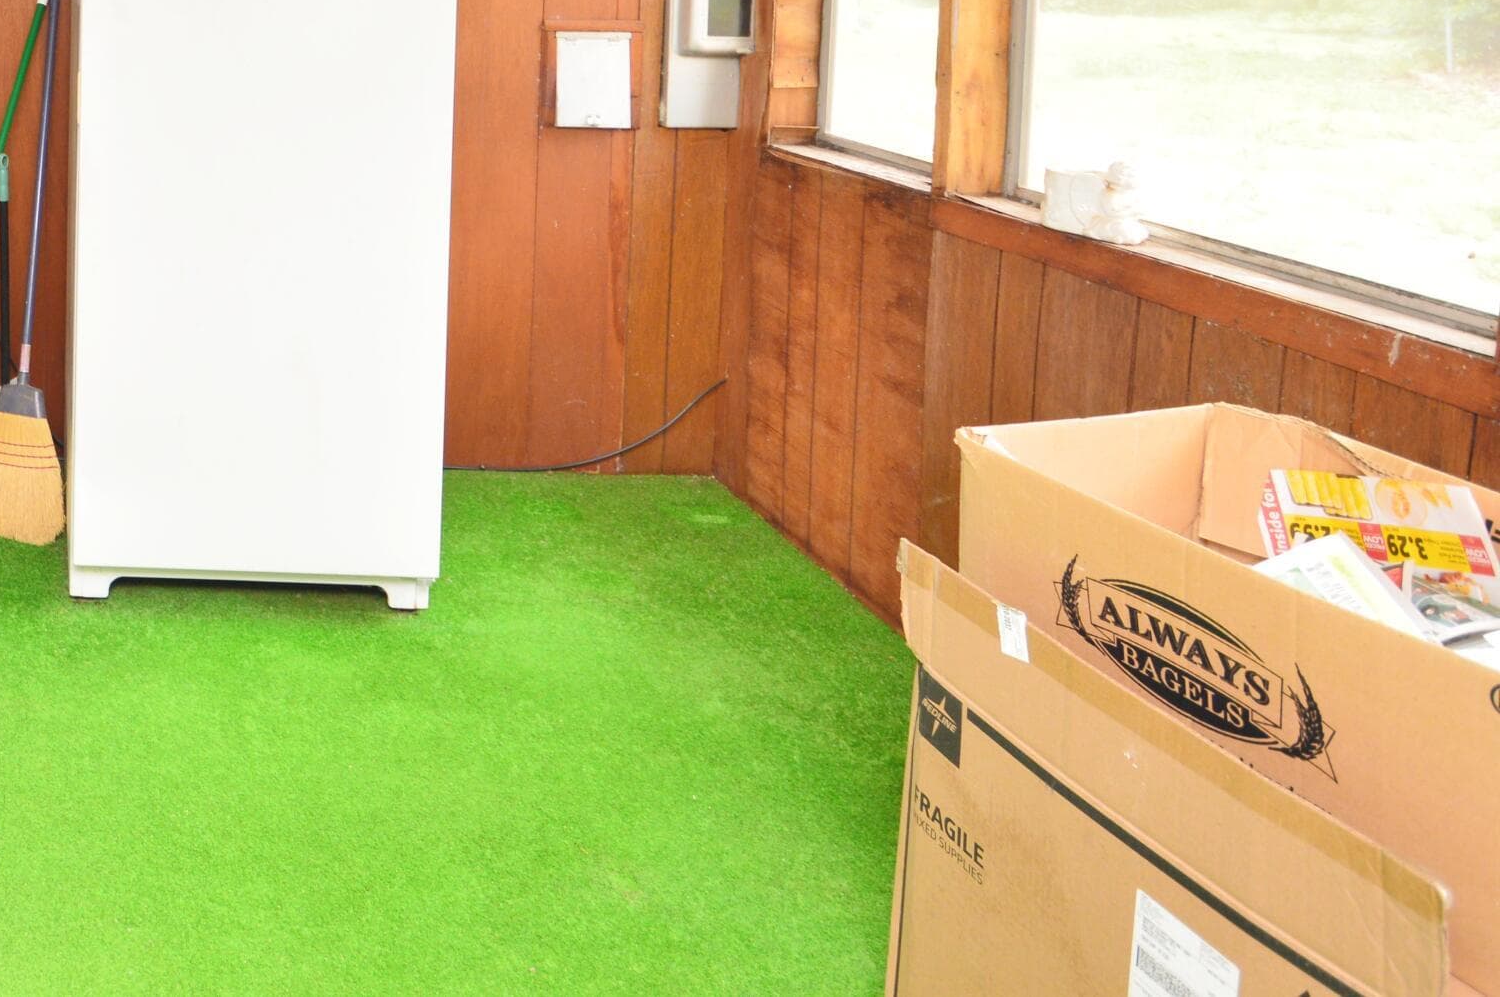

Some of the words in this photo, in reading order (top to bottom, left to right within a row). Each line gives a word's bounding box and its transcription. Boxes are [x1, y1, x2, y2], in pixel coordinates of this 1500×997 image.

[1386, 533, 1428, 561] 3.29
[1098, 596, 1270, 706] ALWAYS
[1121, 641, 1245, 729] BAGELS
[914, 784, 984, 870] FRAGILE
[938, 835, 983, 885] SUPPLIES
